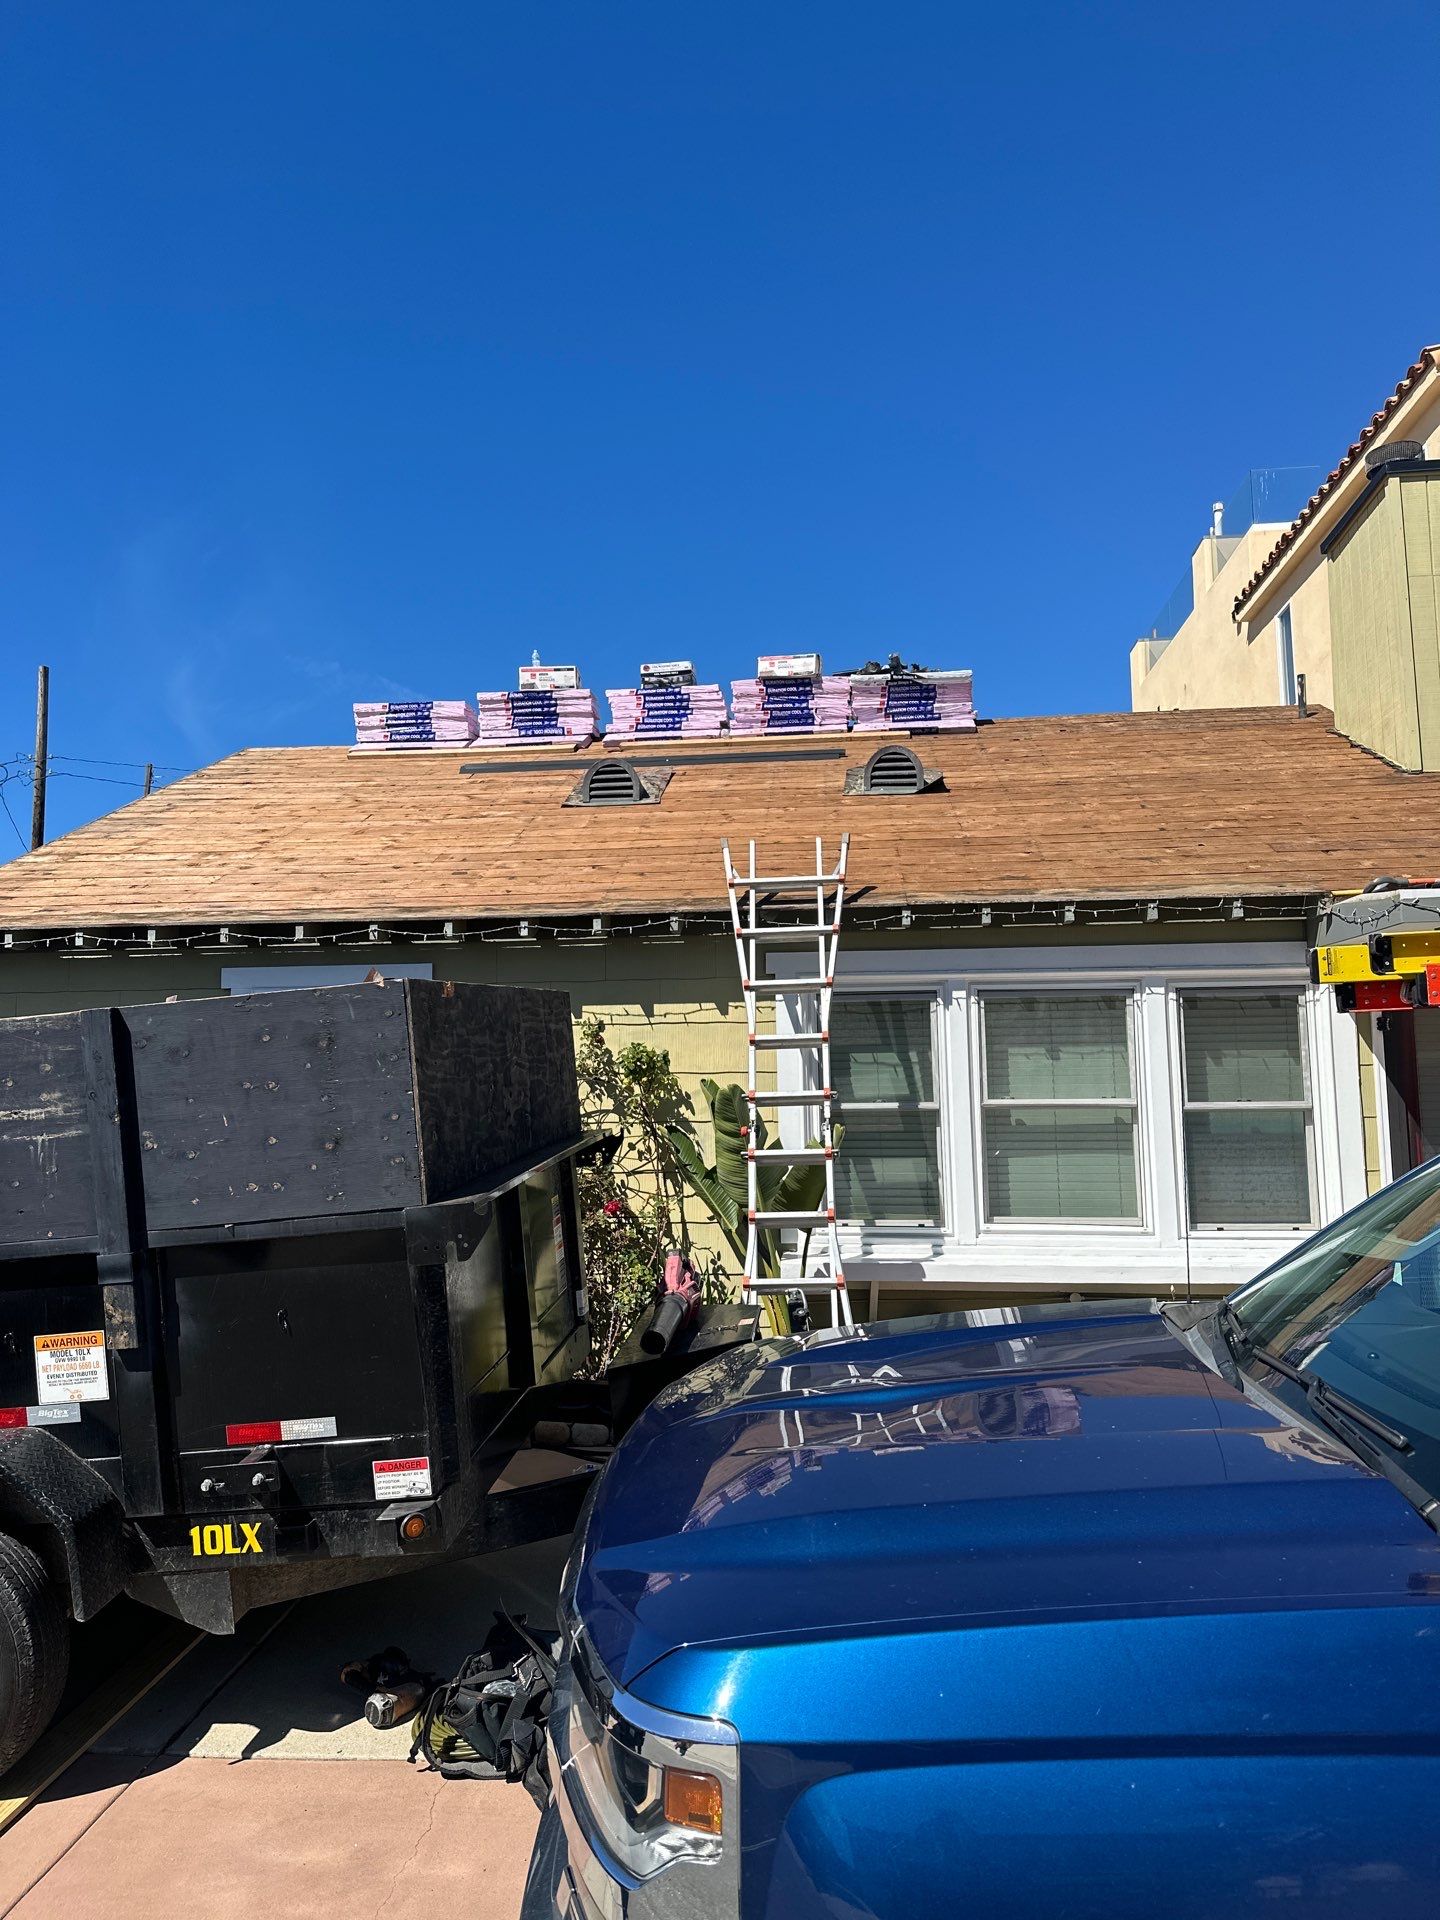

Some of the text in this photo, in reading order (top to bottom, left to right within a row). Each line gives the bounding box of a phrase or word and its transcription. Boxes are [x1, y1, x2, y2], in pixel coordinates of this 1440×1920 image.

[50, 1335, 98, 1348] WARNING
[50, 1348, 91, 1358] MODEL 10LX
[42, 1365, 52, 1374] NET
[53, 1363, 78, 1373] PAYLOAD
[66, 1370, 98, 1378] DISTRIBUTED
[388, 1460, 422, 1471] DANGER
[189, 1522, 264, 1556] 10LX
